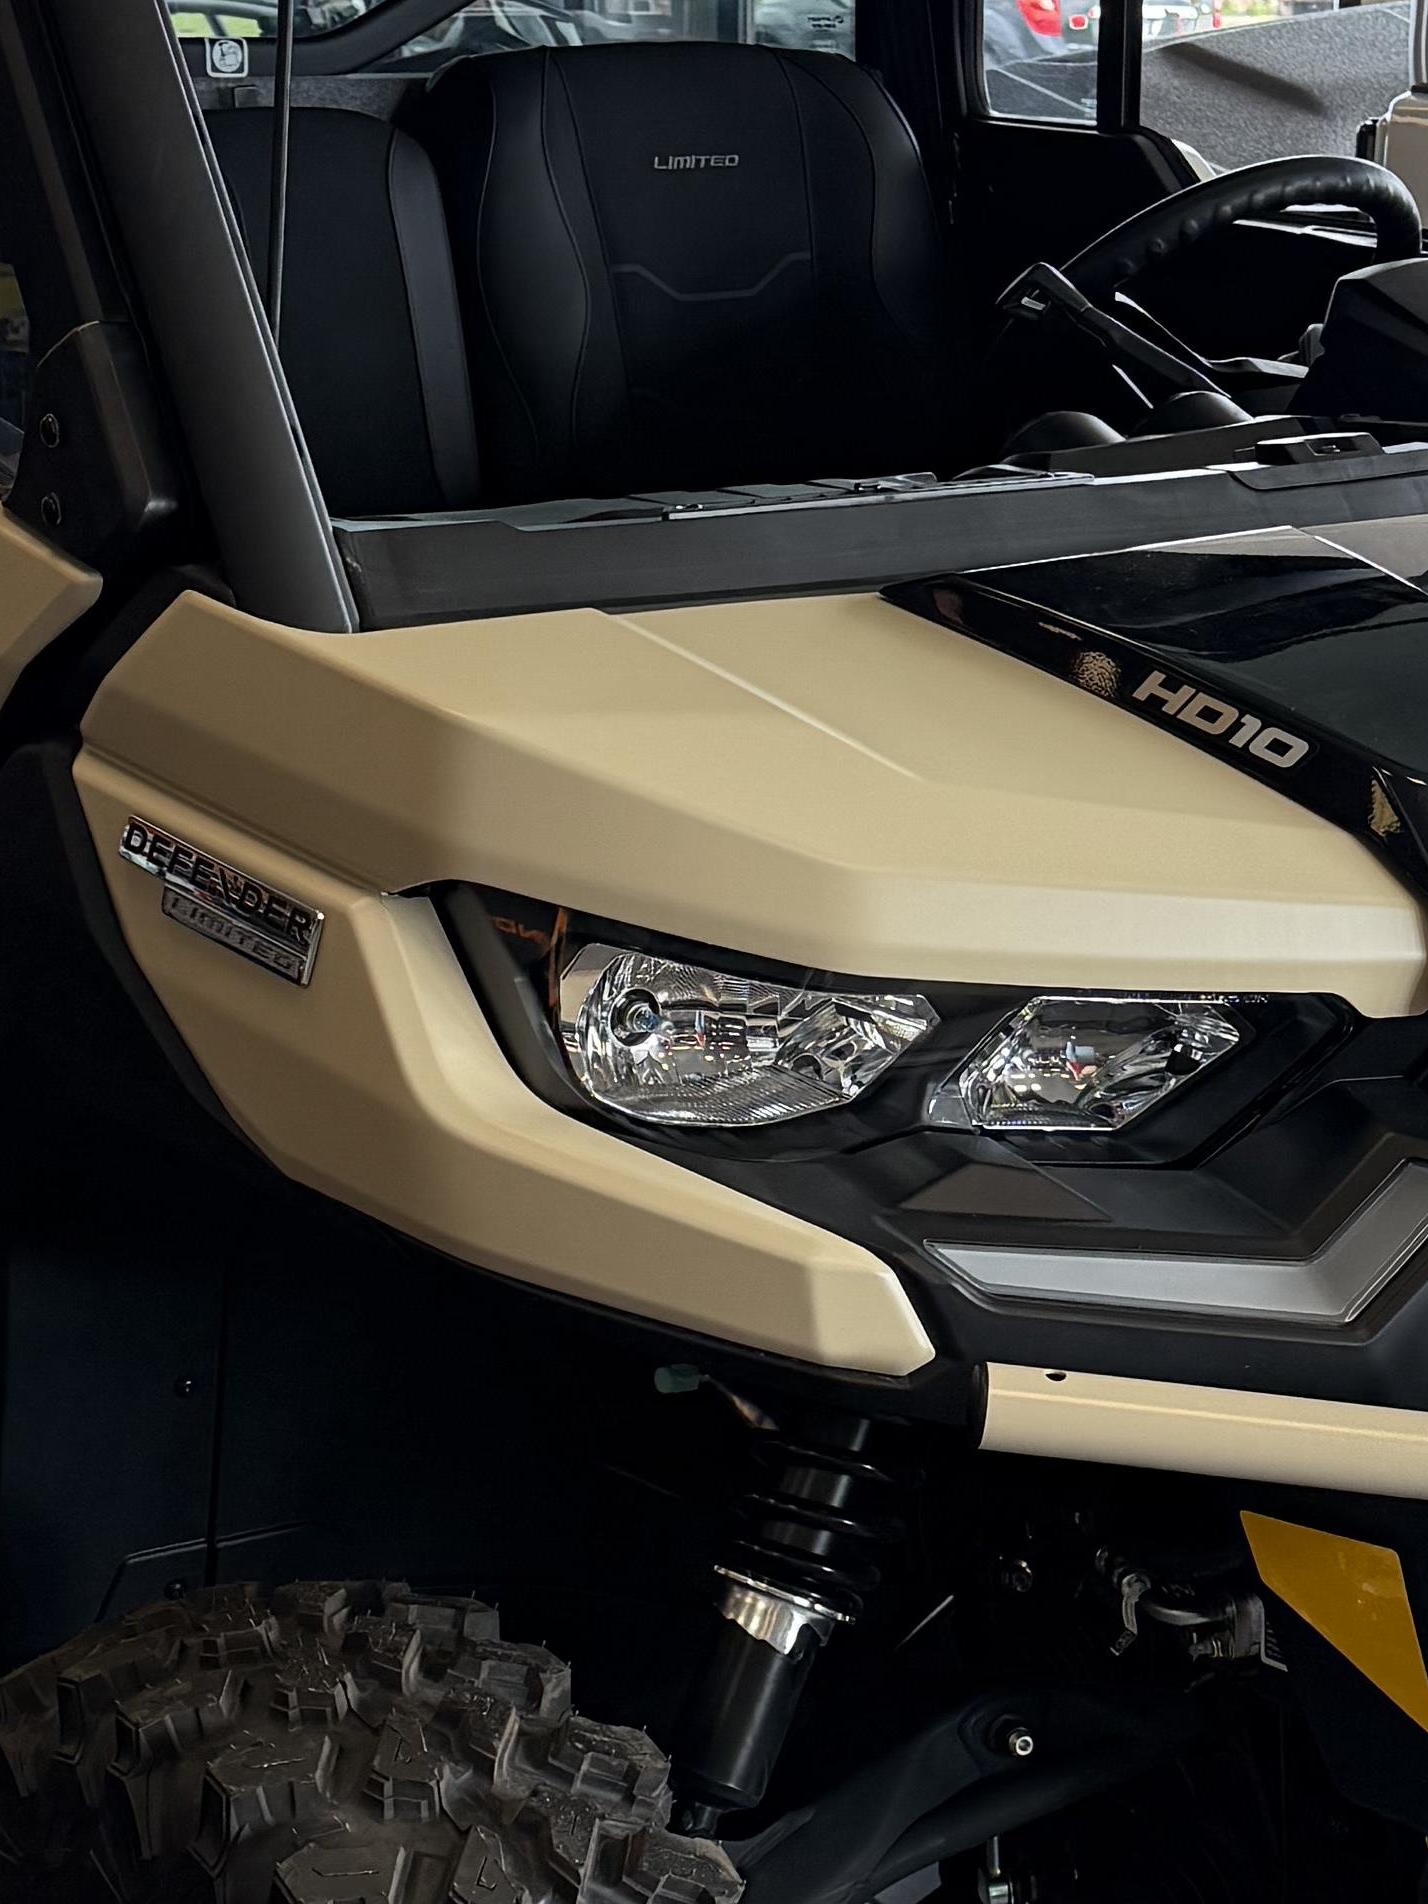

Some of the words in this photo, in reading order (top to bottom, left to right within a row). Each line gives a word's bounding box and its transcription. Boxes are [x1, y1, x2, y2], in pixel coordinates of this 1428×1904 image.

[654, 154, 739, 170] LIMITED
[1132, 669, 1310, 768] HD10
[122, 822, 315, 946] DEFENDER
